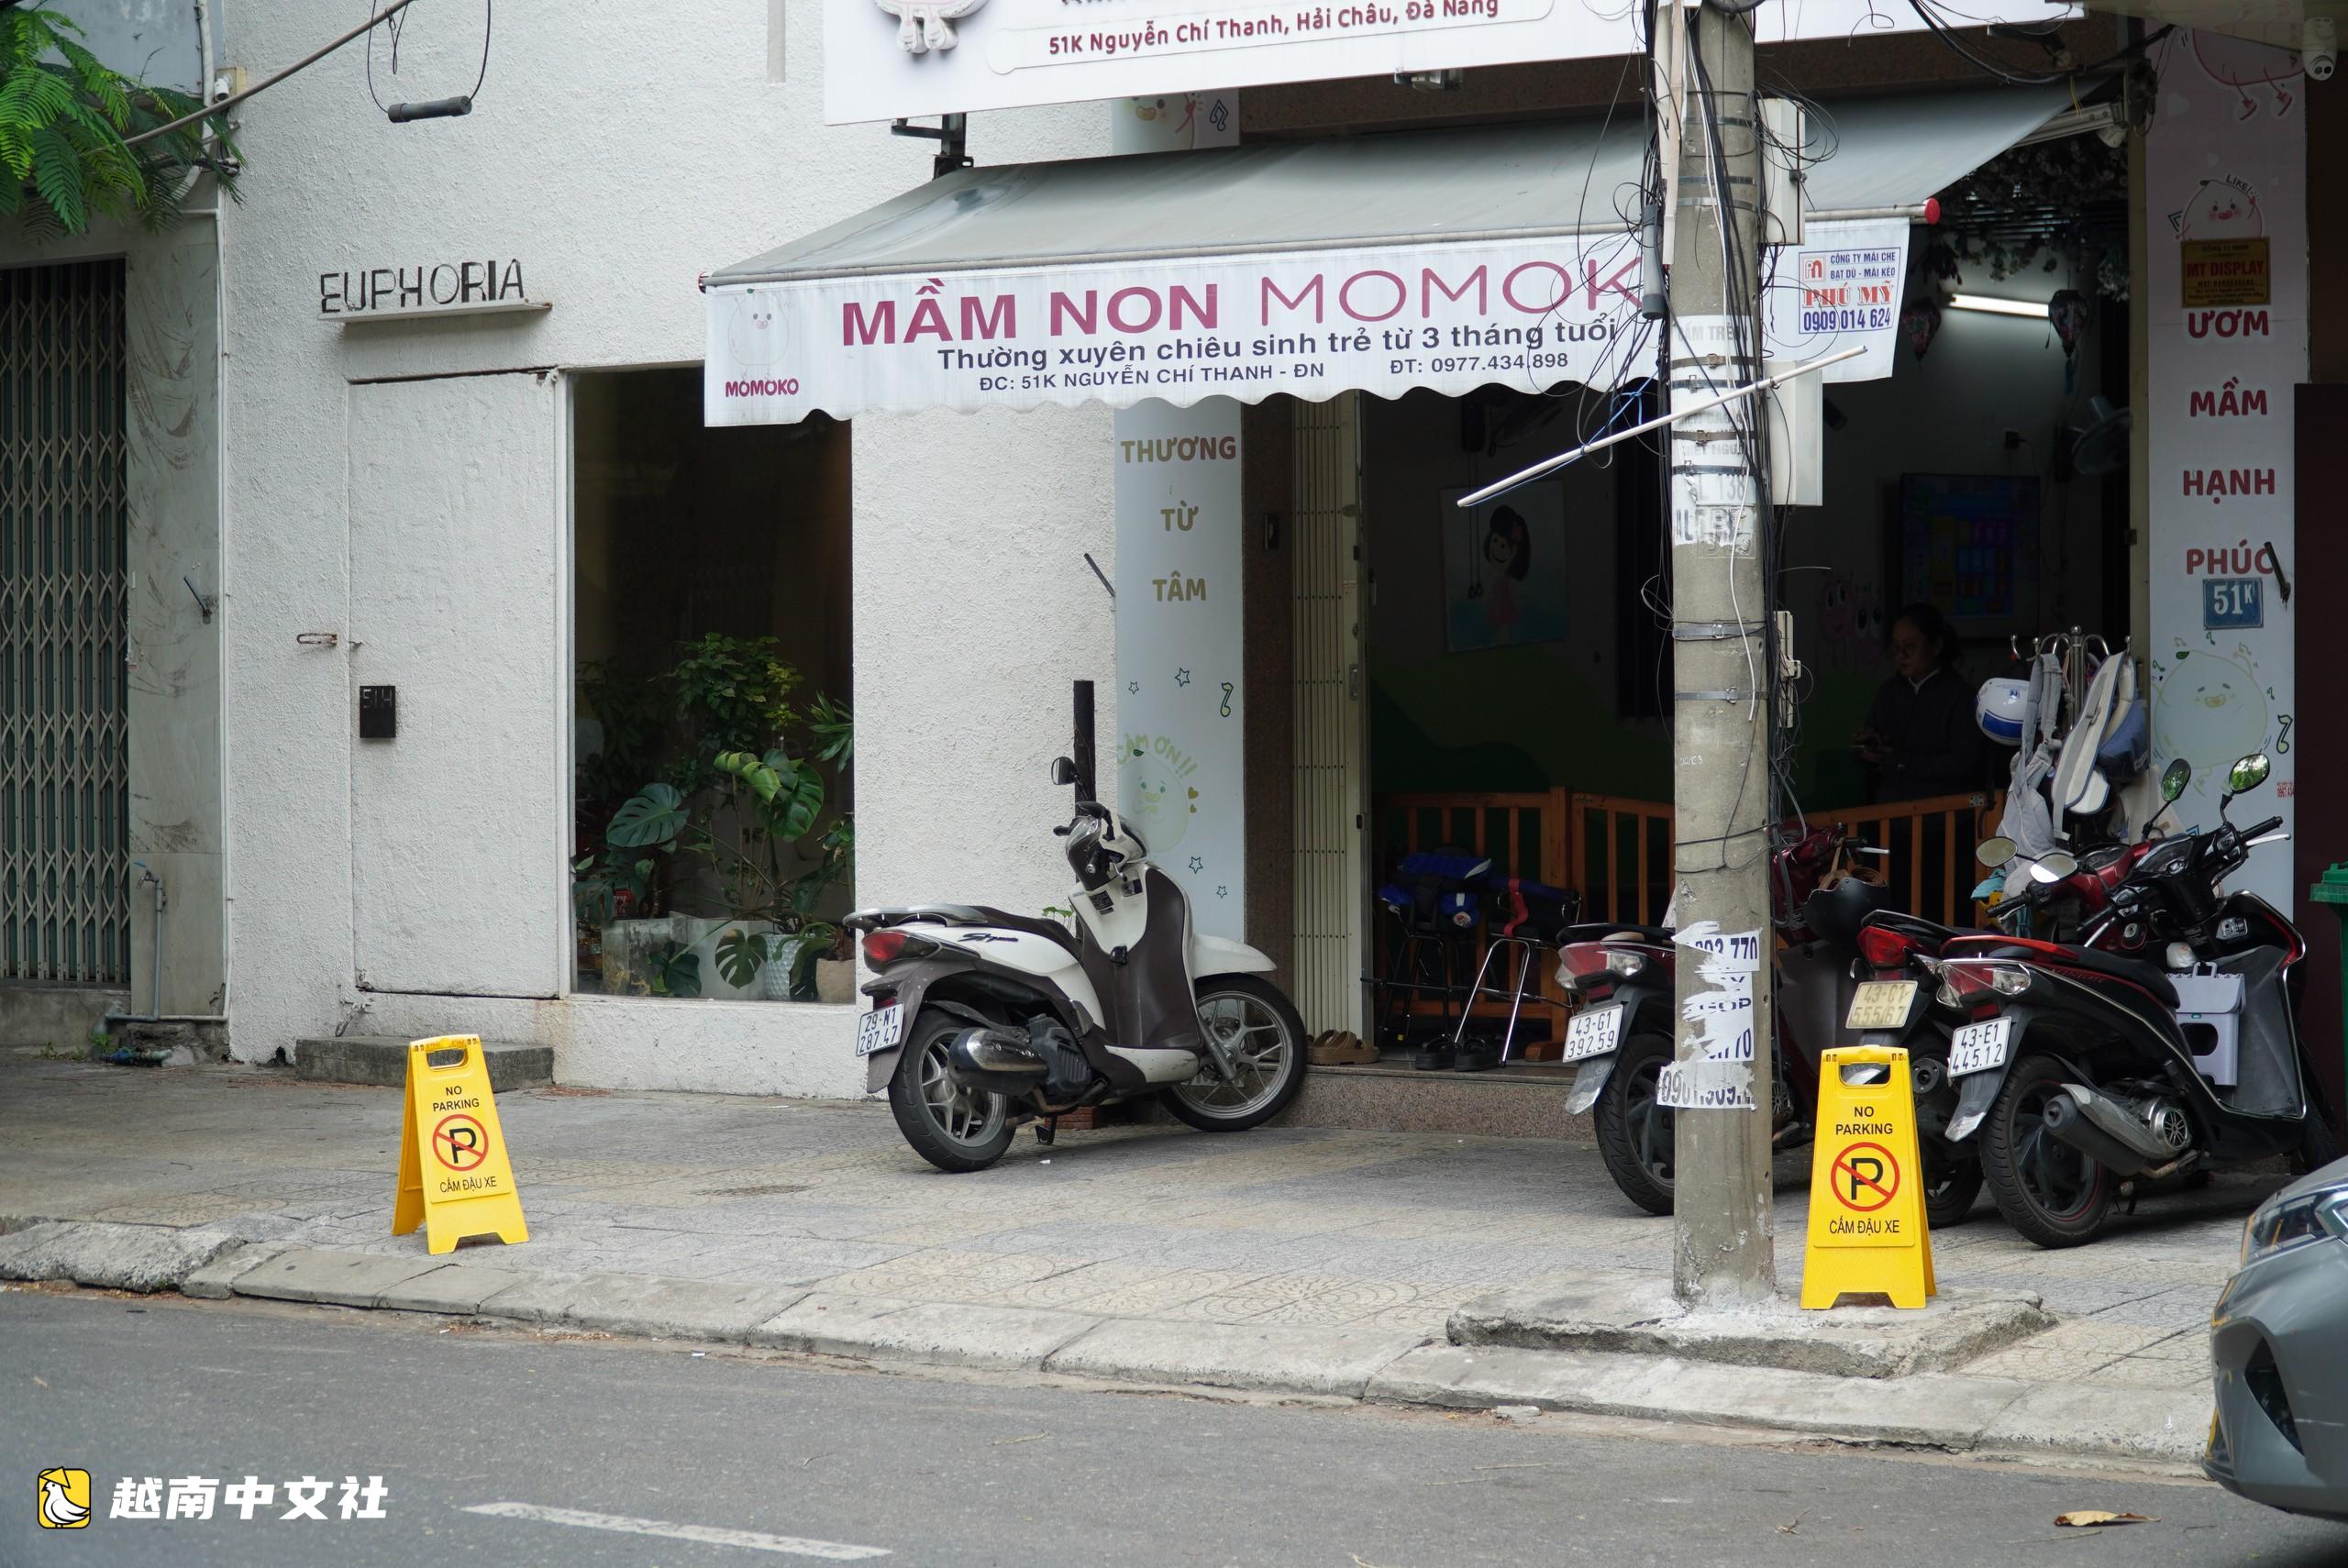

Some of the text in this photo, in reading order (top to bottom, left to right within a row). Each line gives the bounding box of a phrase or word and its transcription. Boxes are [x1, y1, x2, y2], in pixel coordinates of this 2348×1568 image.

[1049, 36, 1082, 55] 51K
[1090, 20, 1168, 55] Nguyễn
[1176, 18, 1210, 43] Chí
[1216, 15, 1290, 39] Thanh,
[1296, 7, 1332, 31] Hải
[1337, 3, 1399, 28] Châu,
[1881, 251, 1896, 261] CHE
[2210, 259, 2265, 277] DISPLAY
[321, 258, 525, 314] EUPHORIA
[1802, 282, 1851, 308] PHÚ
[843, 278, 1016, 346] MẦM
[1050, 283, 1218, 337] NON
[1803, 308, 1891, 331] 0909 014 624
[2187, 308, 2269, 338] ƯƠM
[937, 312, 1617, 371] Thường xuyên chiêu sinh trẻ từ 3 tháng tuổi
[980, 377, 1014, 392] ĐC:
[1021, 373, 1057, 391] 51K
[1064, 364, 1149, 389] NGUYỄN
[1157, 364, 1193, 385] CHÍ
[1201, 364, 1273, 382] THANH
[1293, 362, 1324, 378] ĐN
[1390, 359, 1423, 375] ĐT:
[1431, 352, 1569, 373] 0977.434.898
[725, 378, 800, 398] MOMOKO
[2189, 376, 2268, 417] MẦM
[1121, 436, 1236, 463] THƯƠNG
[2183, 469, 2276, 504] HẠNH
[1160, 500, 1199, 531] TỪ
[2187, 538, 2275, 575] PHÚC
[1152, 570, 1207, 602] TÂM
[2213, 583, 2253, 615] 51K
[1575, 1010, 1612, 1036] 43-G1
[1960, 1022, 2000, 1050] 43-E1
[858, 1024, 898, 1054] 287.47
[1567, 1030, 1615, 1058] 392.59
[1952, 1043, 2003, 1072] 445.12
[445, 1085, 462, 1096] NO
[433, 1098, 480, 1112] PARKING
[1854, 1106, 1875, 1118] NO
[1835, 1123, 1893, 1135] PARKING
[484, 1176, 497, 1188] XE
[1829, 1215, 1900, 1236] CẤM ĐẬU XE
